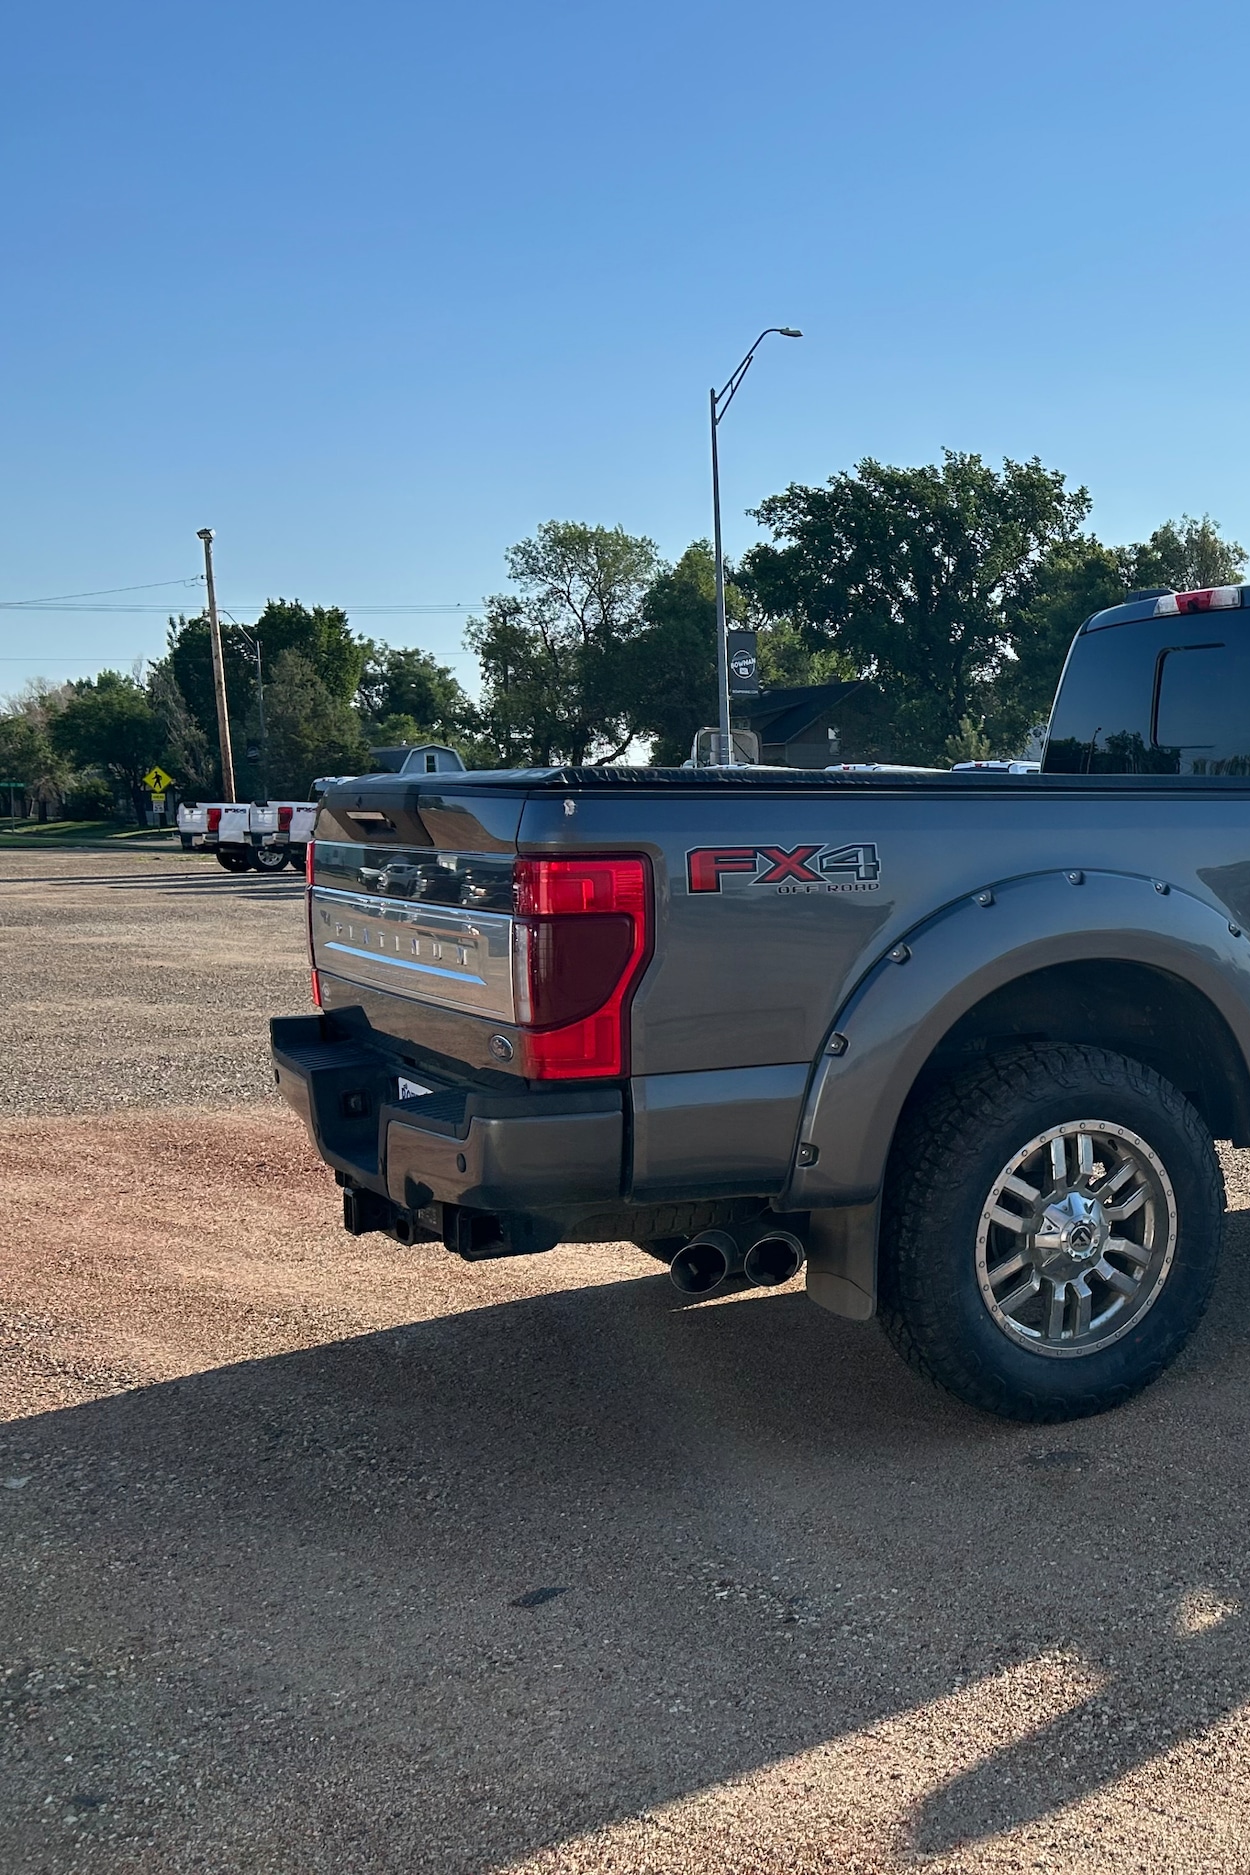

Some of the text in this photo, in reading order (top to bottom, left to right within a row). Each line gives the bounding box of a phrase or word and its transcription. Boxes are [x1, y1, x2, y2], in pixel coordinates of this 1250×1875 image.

[731, 657, 756, 669] BOWMAN
[685, 842, 881, 896] FX4
[776, 882, 881, 895] OFF ROAD
[335, 922, 468, 966] PLATINUM
